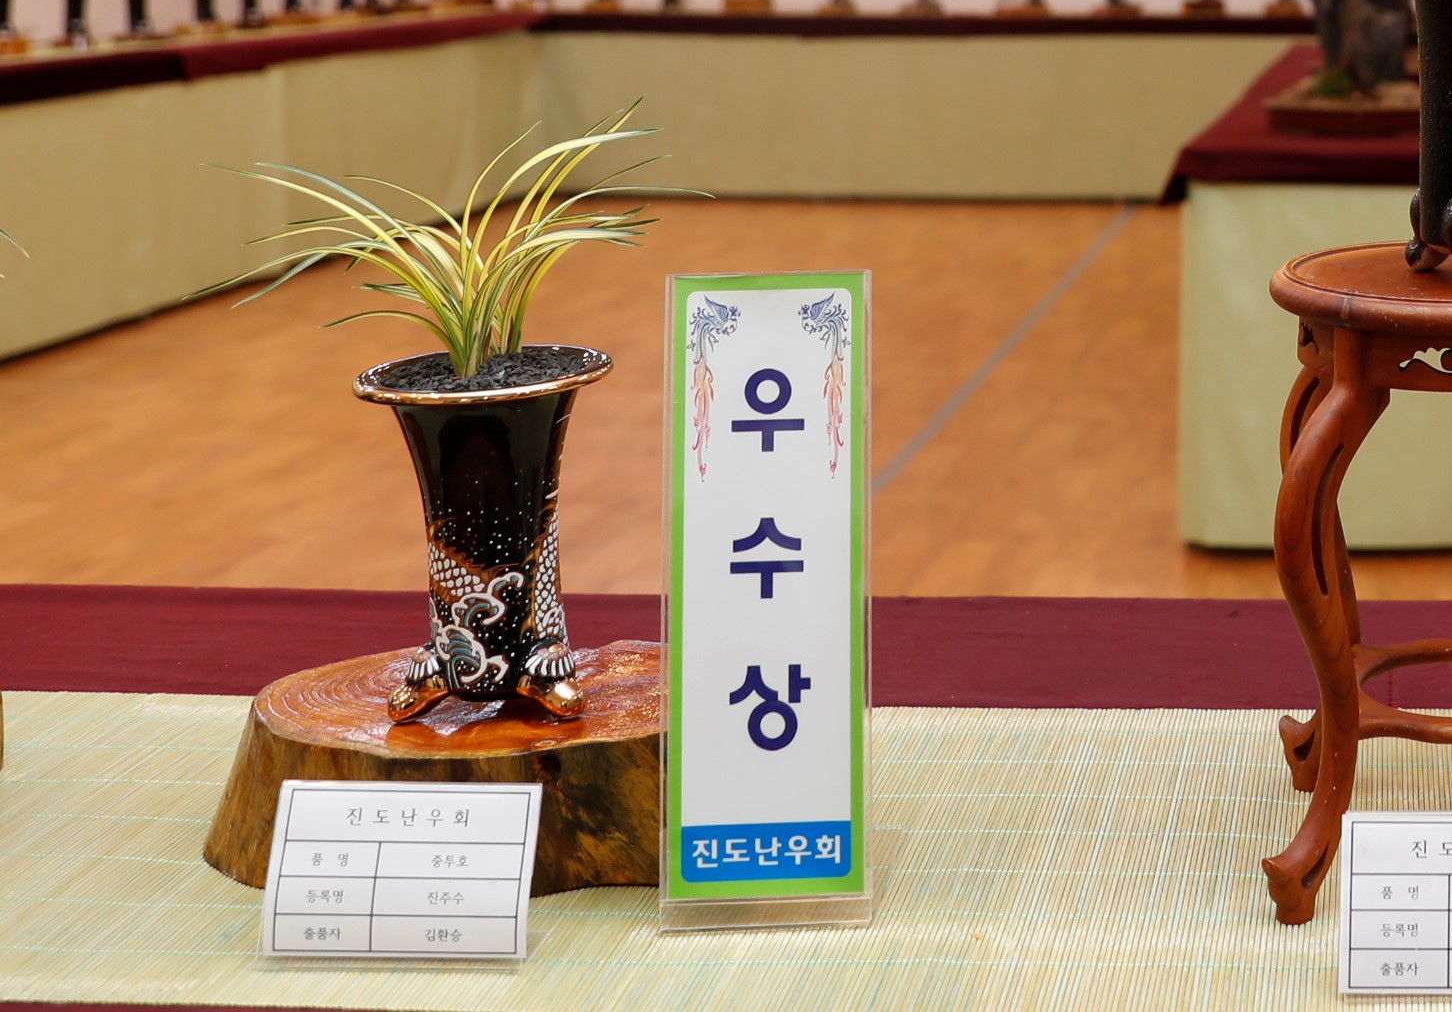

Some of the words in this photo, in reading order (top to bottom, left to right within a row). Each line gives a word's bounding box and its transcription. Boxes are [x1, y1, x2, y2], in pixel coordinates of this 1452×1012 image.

[728, 367, 812, 752] 우수상
[692, 835, 841, 868] 진도난우회
[432, 854, 468, 869] 중투호
[307, 889, 344, 904] 등록명
[427, 891, 465, 905] 진주수
[303, 927, 342, 941] 출품자
[425, 928, 462, 942] 김환승
[1381, 923, 1419, 938] 등록명
[1380, 961, 1418, 977] 출품자
